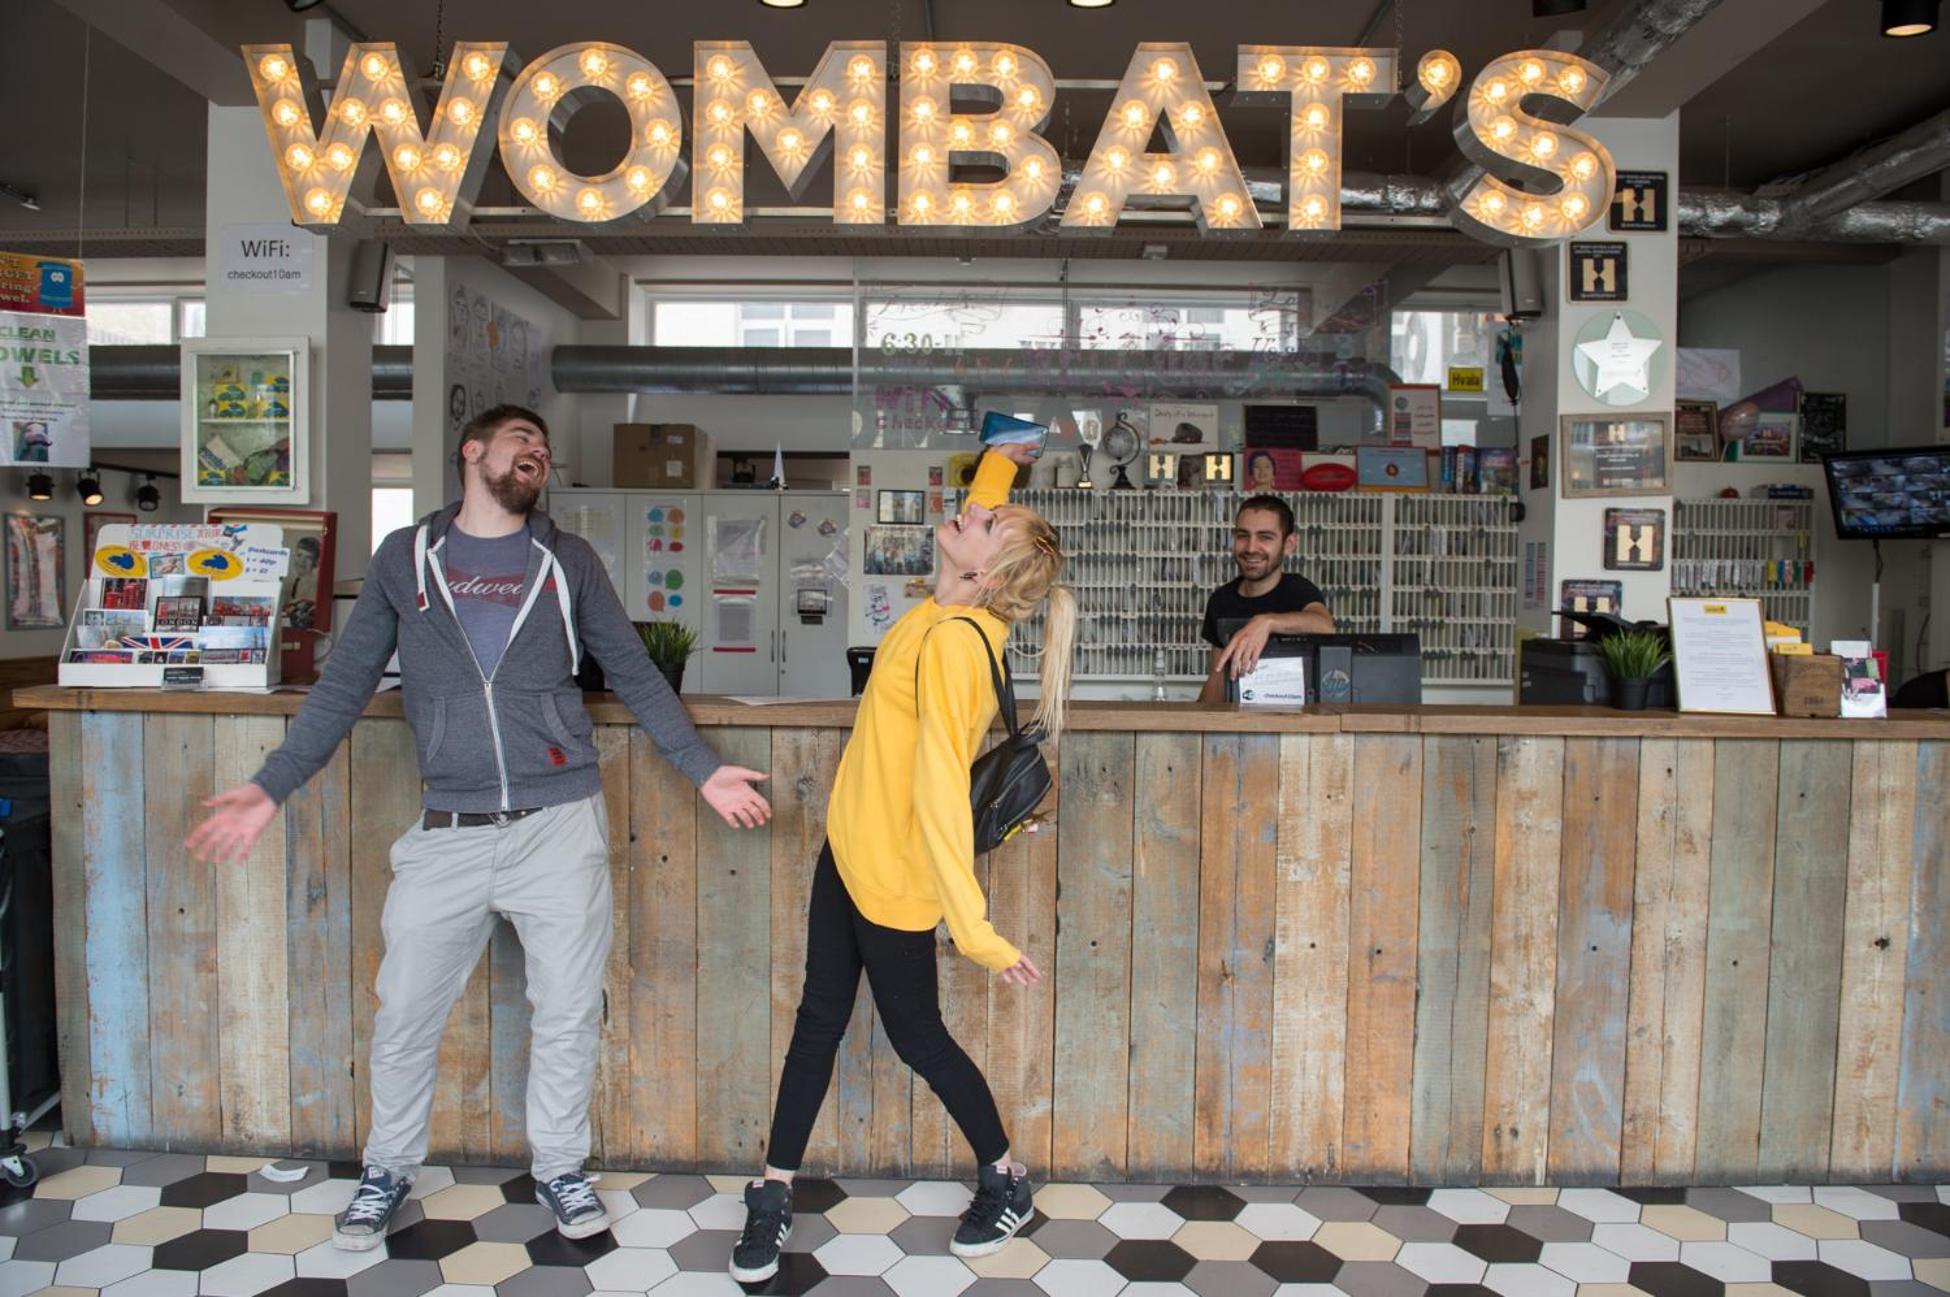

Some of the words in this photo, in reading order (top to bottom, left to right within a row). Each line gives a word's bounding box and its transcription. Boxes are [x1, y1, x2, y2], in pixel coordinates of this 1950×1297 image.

[240, 38, 1618, 240] WOMBAT'S
[241, 240, 290, 258] WiFi:
[227, 270, 301, 280] checkout10am
[0, 346, 80, 365] OWELS
